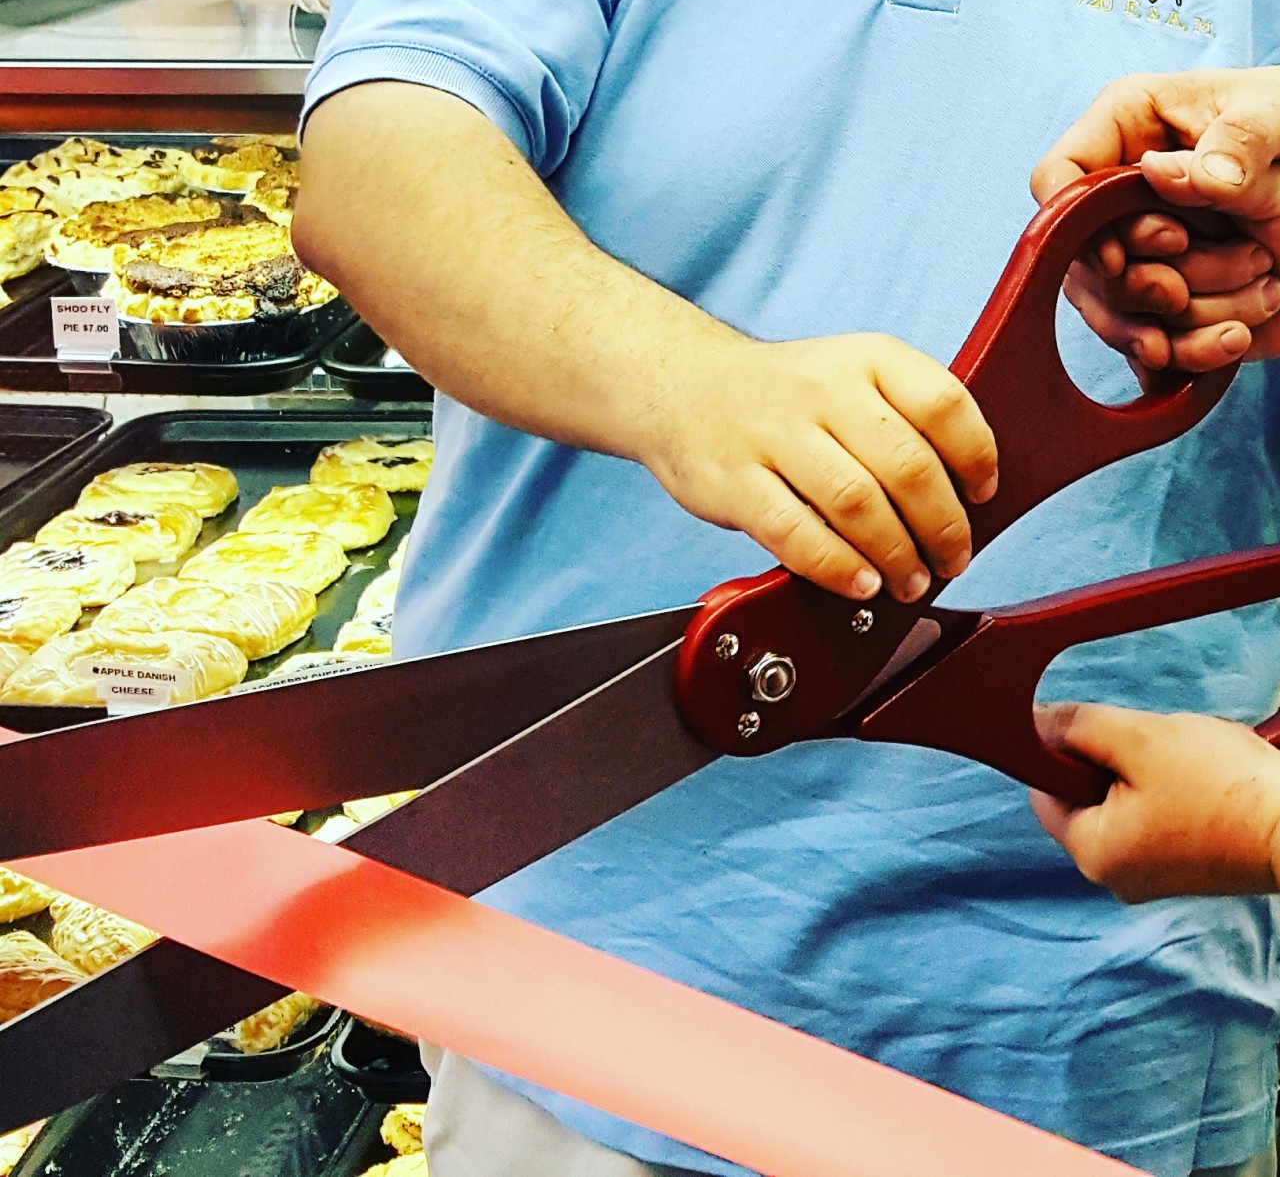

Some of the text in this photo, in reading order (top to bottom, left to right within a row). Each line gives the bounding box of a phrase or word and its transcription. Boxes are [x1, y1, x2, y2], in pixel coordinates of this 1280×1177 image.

[57, 305, 111, 314] SHOO FLY
[63, 324, 109, 333] PIE $7.00
[137, 671, 177, 682] DANISH
[111, 686, 156, 696] CHEESE
